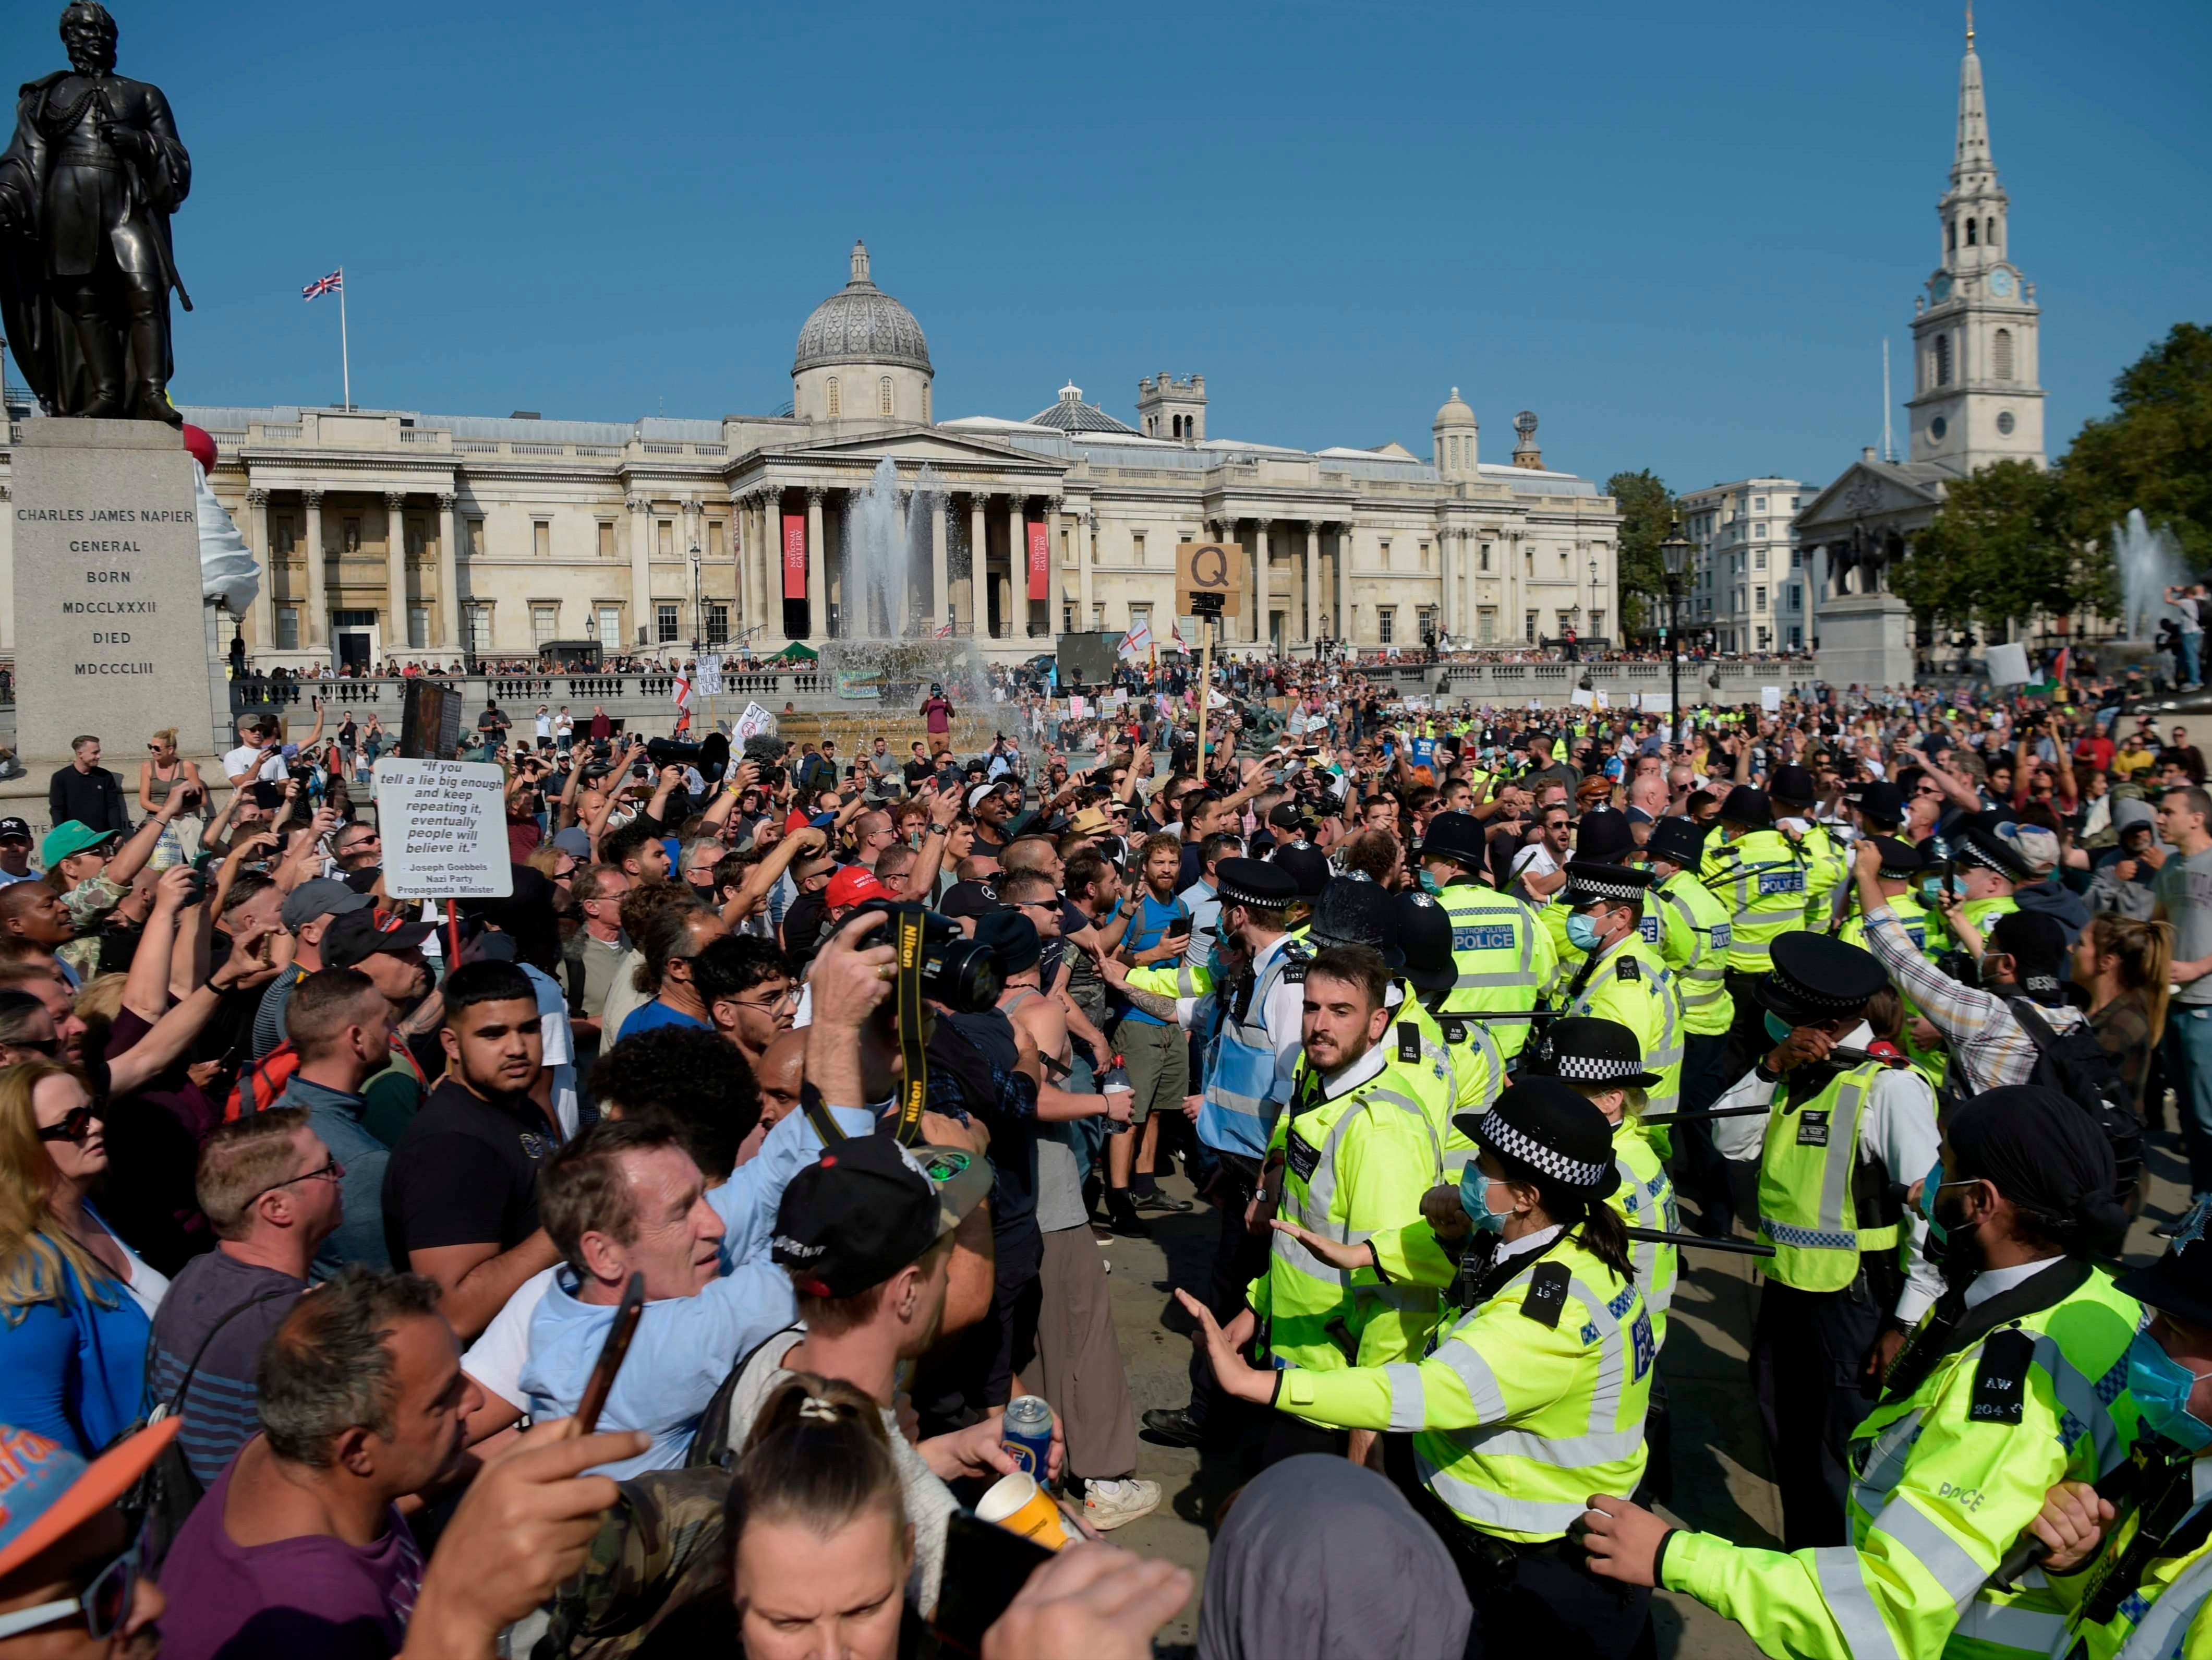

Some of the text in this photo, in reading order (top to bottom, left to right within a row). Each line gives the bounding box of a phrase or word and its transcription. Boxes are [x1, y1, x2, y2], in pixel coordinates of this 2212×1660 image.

[17, 509, 194, 522] CHARLES JAMES NAPIER
[70, 541, 141, 552] GENERAL
[1191, 546, 1229, 587] Q
[87, 572, 130, 583] BORN
[63, 602, 156, 613] MDCCLXXXII
[93, 632, 130, 643] DIED
[75, 663, 153, 675] MDCCCLIII
[746, 705, 770, 726] STOP
[440, 764, 462, 774] you
[381, 774, 403, 784] tell
[419, 775, 434, 785] lie
[439, 776, 457, 788] big
[461, 778, 503, 791] enough
[415, 788, 473, 801] and keep
[406, 802, 481, 815] repeating it,
[411, 816, 477, 829] eventually
[407, 829, 478, 840] people will
[406, 843, 454, 853] believe
[409, 864, 444, 873] Joseph
[450, 875, 473, 884] Party
[397, 886, 454, 895] Propaganda
[1760, 879, 1802, 893] POLICE
[1453, 925, 1513, 934] METROPOLITAN
[903, 924, 917, 968] Nikon
[1454, 934, 1514, 949] POLICE
[905, 1080, 922, 1122] Nikon
[1545, 1280, 1561, 1291] SE
[1984, 1377, 2013, 1390] AW
